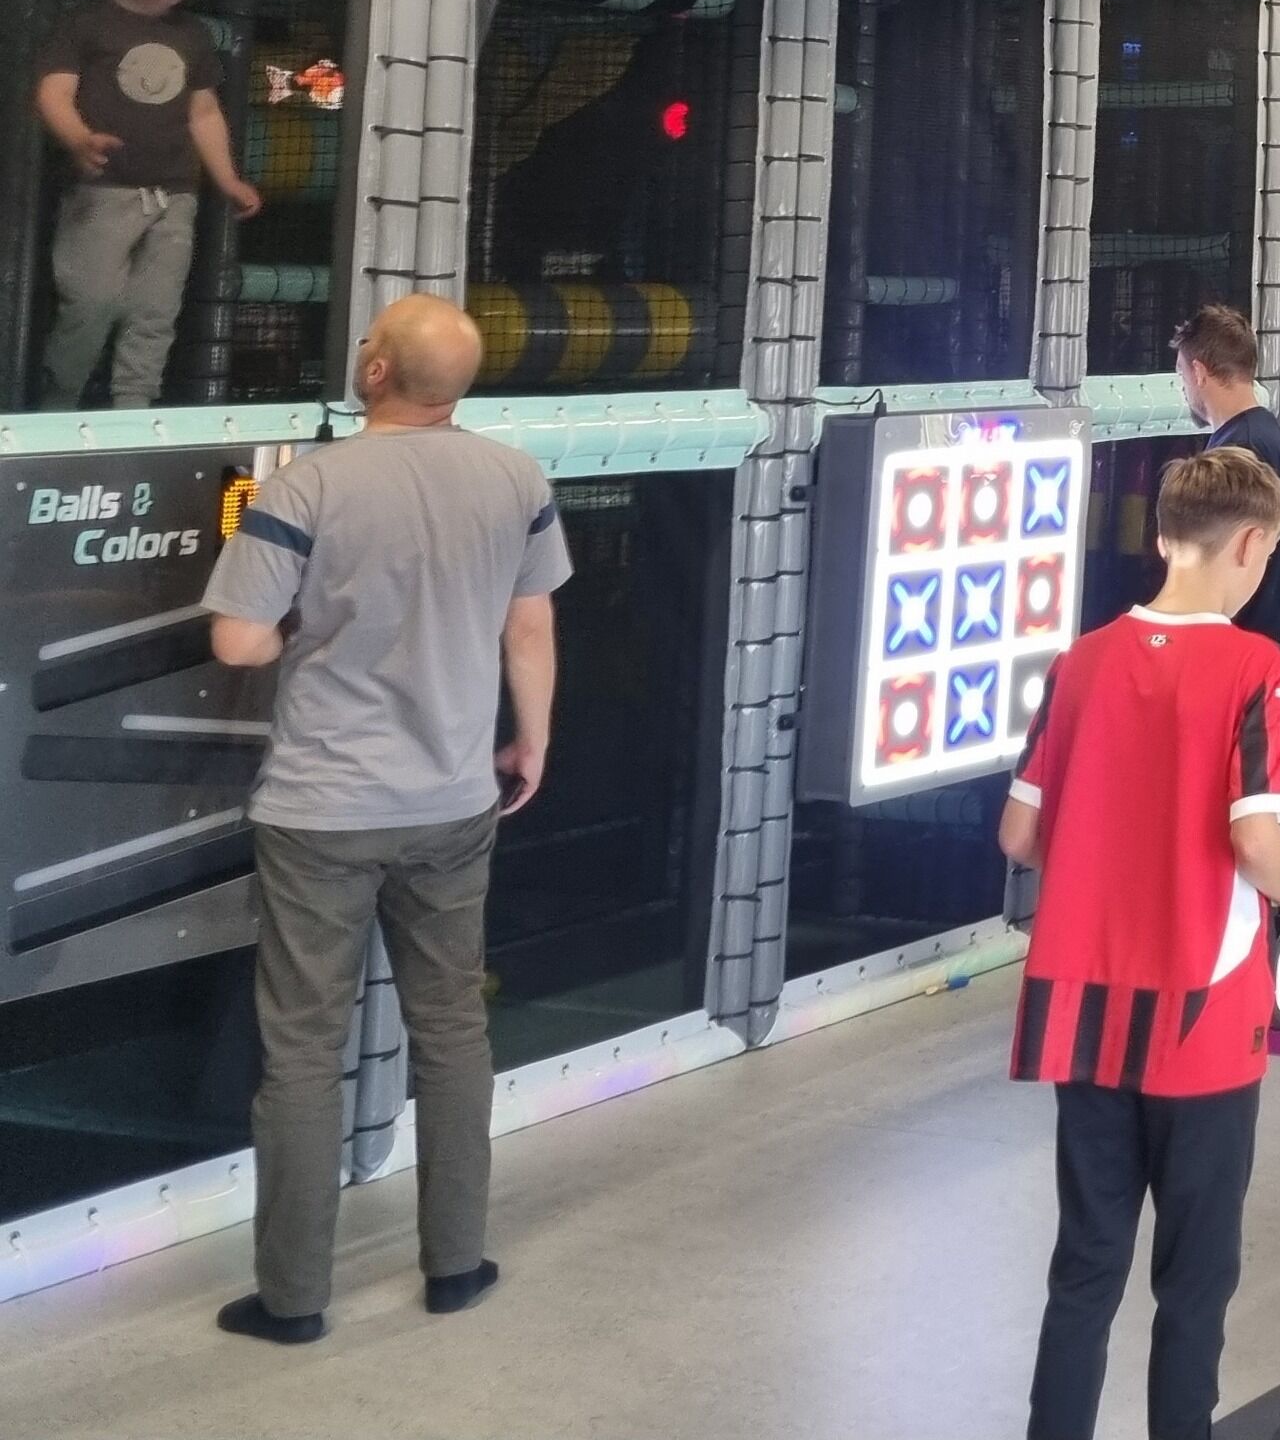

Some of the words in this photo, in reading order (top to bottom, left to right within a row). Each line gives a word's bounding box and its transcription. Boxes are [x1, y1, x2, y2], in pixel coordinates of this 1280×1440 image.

[28, 486, 124, 525] Balls
[131, 483, 153, 516] &
[73, 526, 201, 565] Colors
